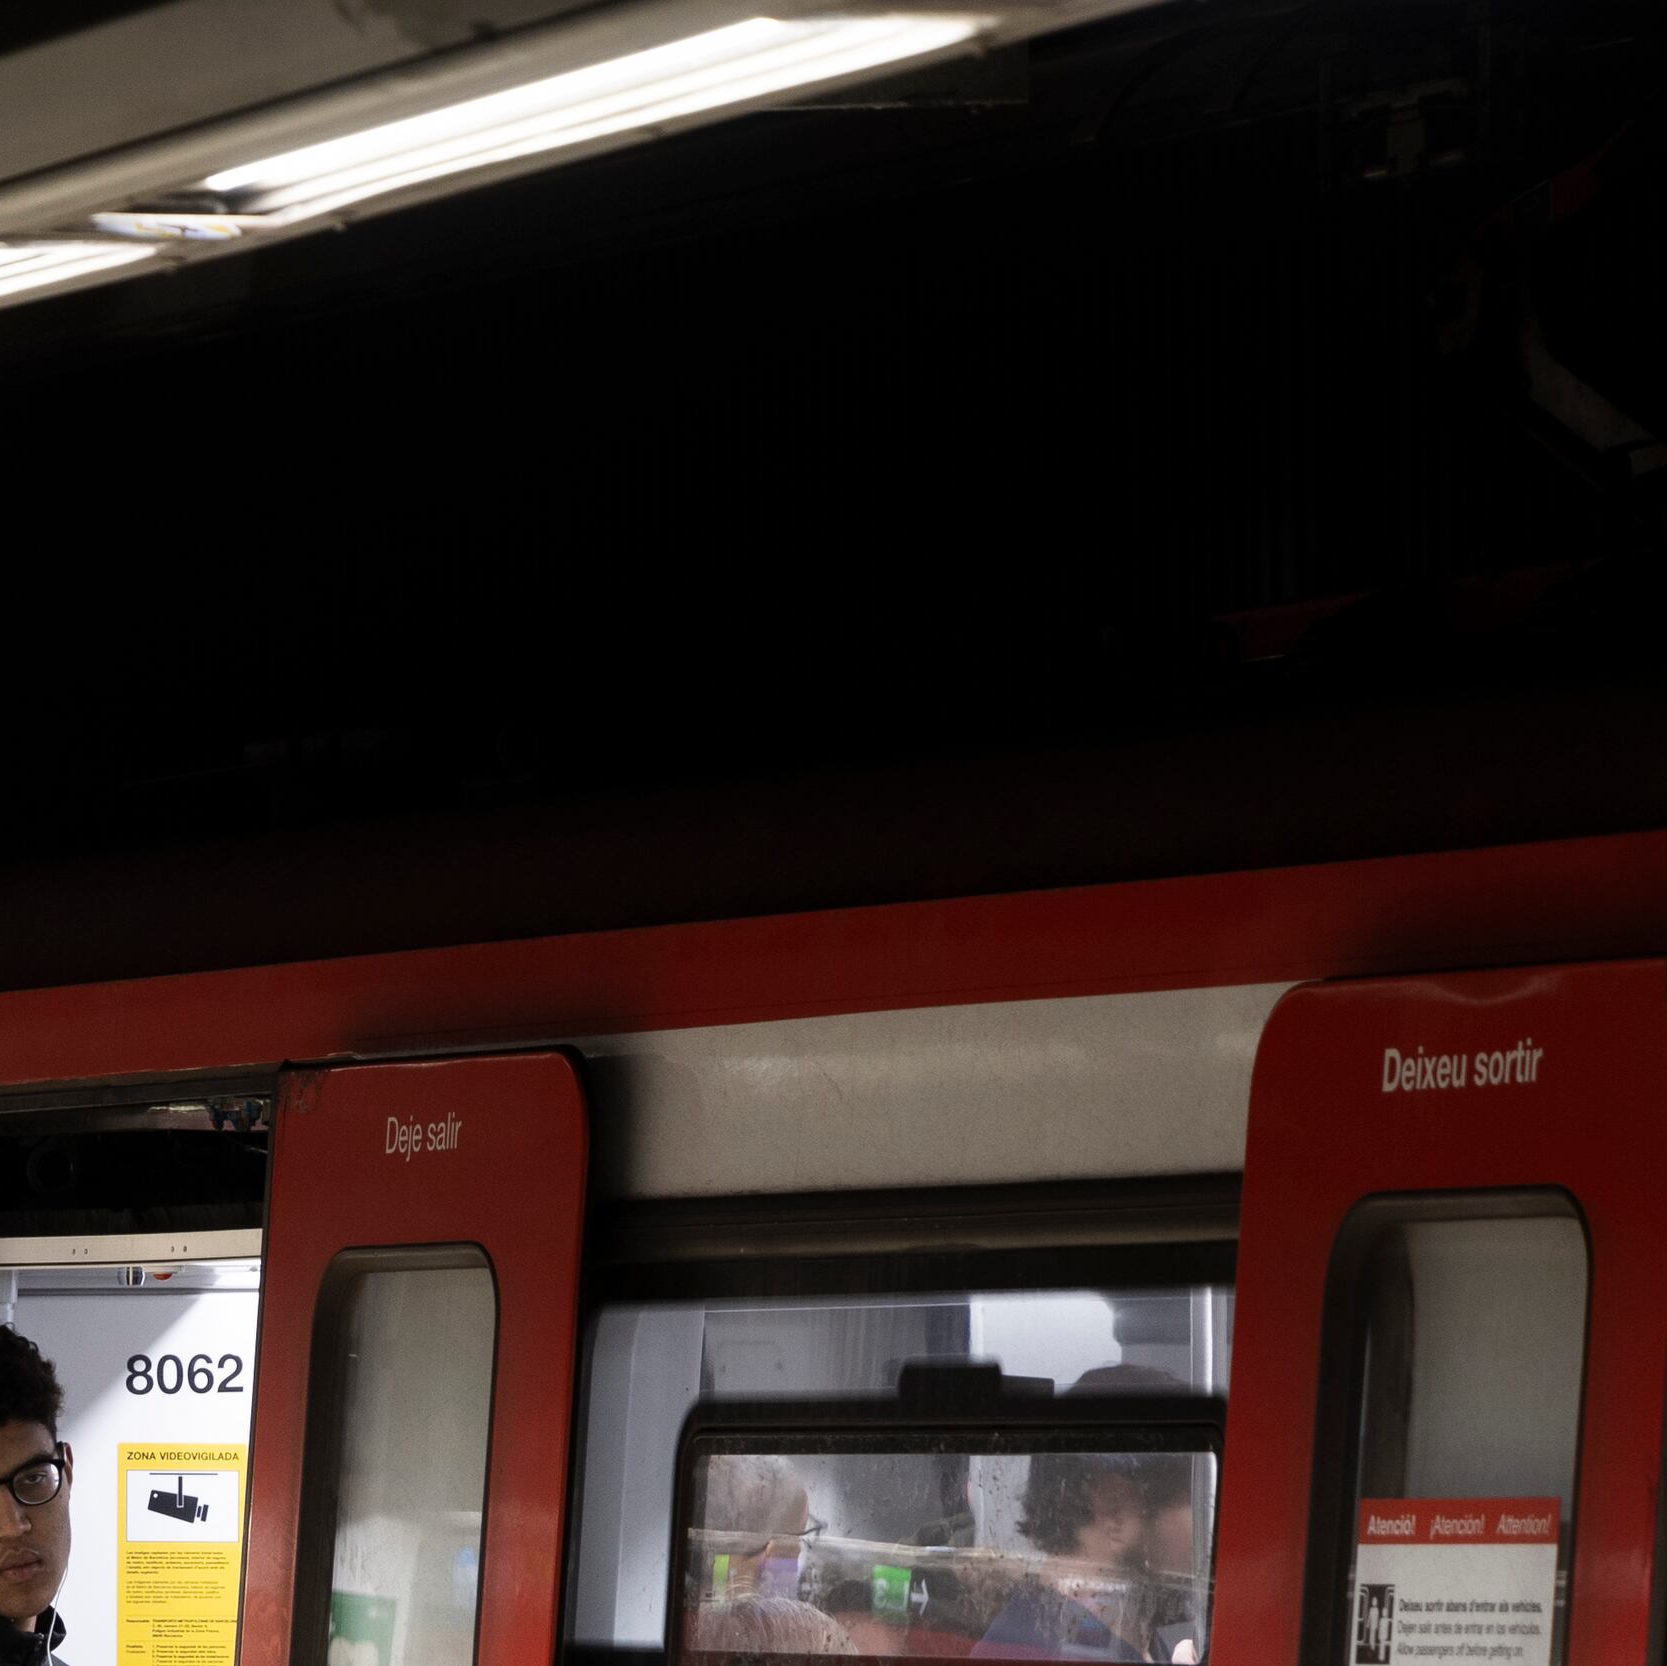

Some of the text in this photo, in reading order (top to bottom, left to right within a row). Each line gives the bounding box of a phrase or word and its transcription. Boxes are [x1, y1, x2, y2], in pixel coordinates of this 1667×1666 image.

[1382, 1037, 1543, 1092] Deixeu sortir
[385, 1112, 463, 1162] Deje salir
[126, 1353, 244, 1395] 8062
[126, 1451, 240, 1461] ZONA VIDEOVIGILADA
[1367, 1514, 1416, 1536] Atenció!
[1496, 1513, 1552, 1536] Attention!
